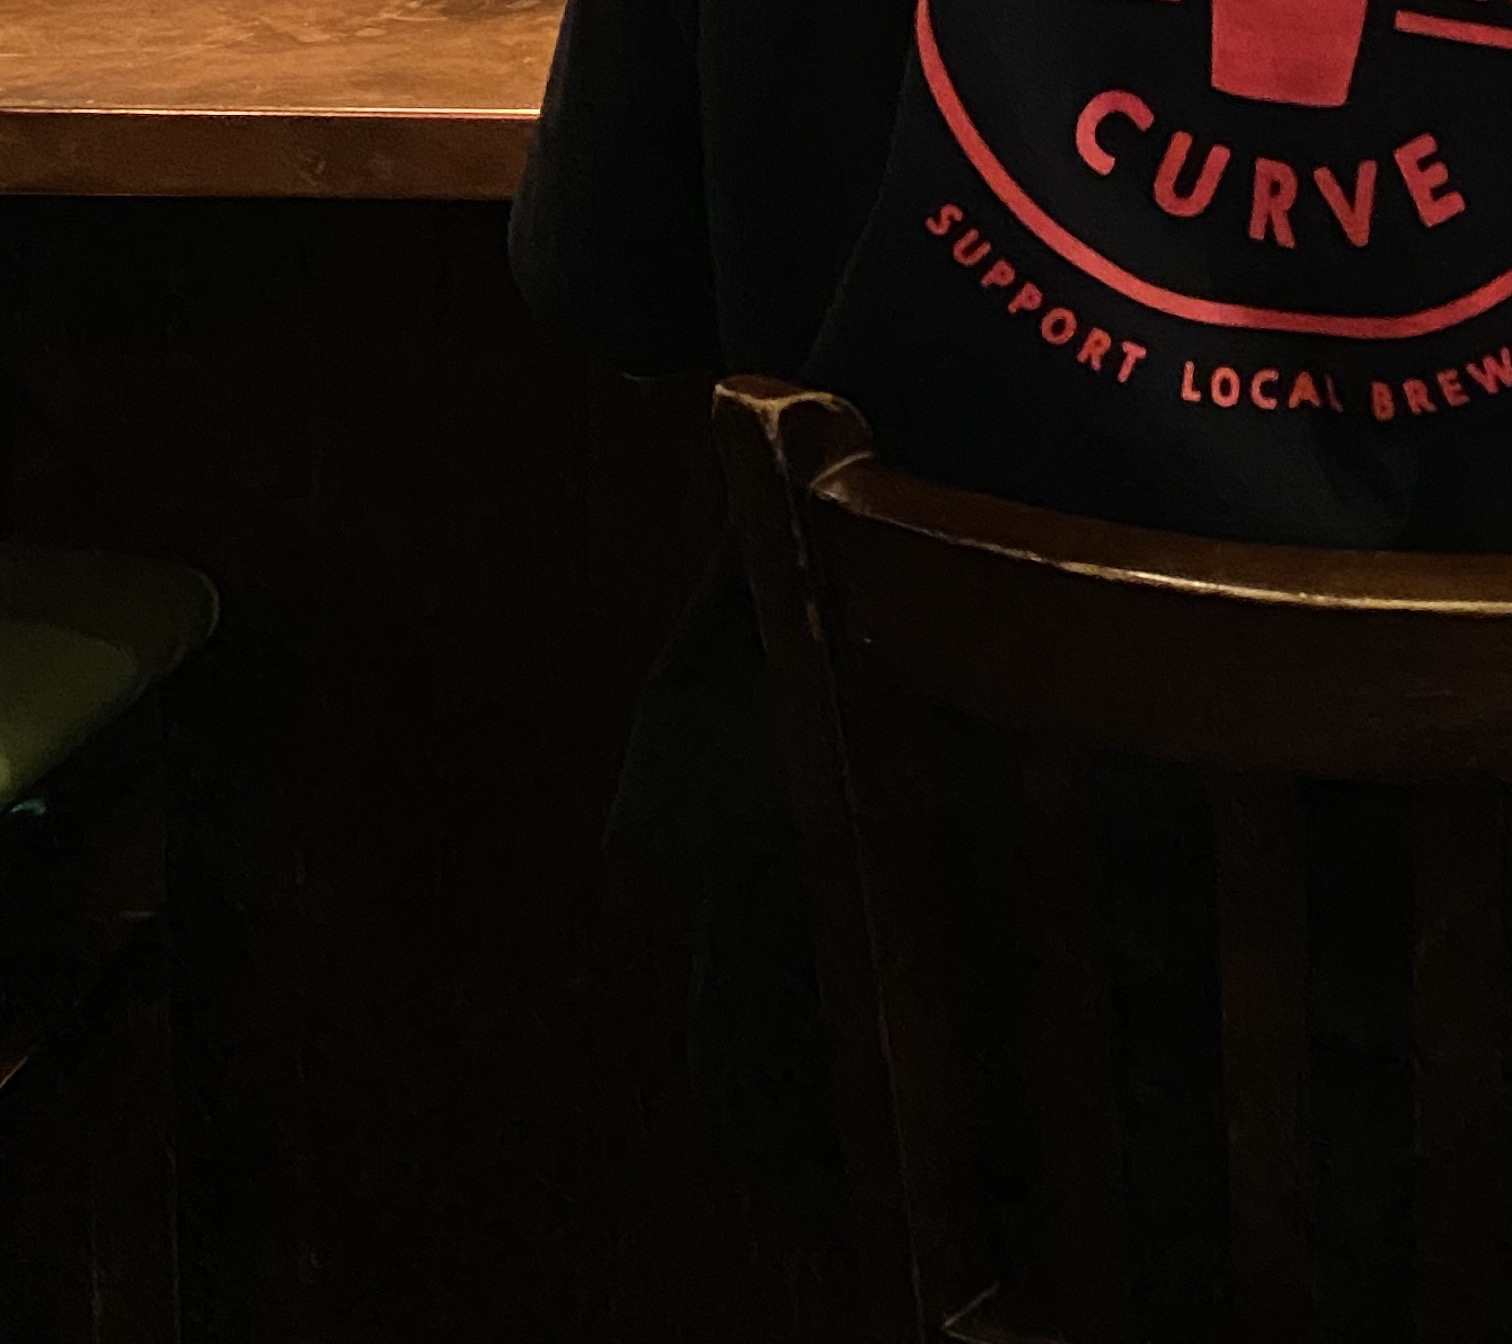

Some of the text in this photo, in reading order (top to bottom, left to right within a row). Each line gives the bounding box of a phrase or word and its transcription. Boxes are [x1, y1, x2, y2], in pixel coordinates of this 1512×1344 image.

[1075, 89, 1467, 249] CURVE
[925, 202, 1147, 385] SUPPORT
[1180, 360, 1344, 413] LOCAL
